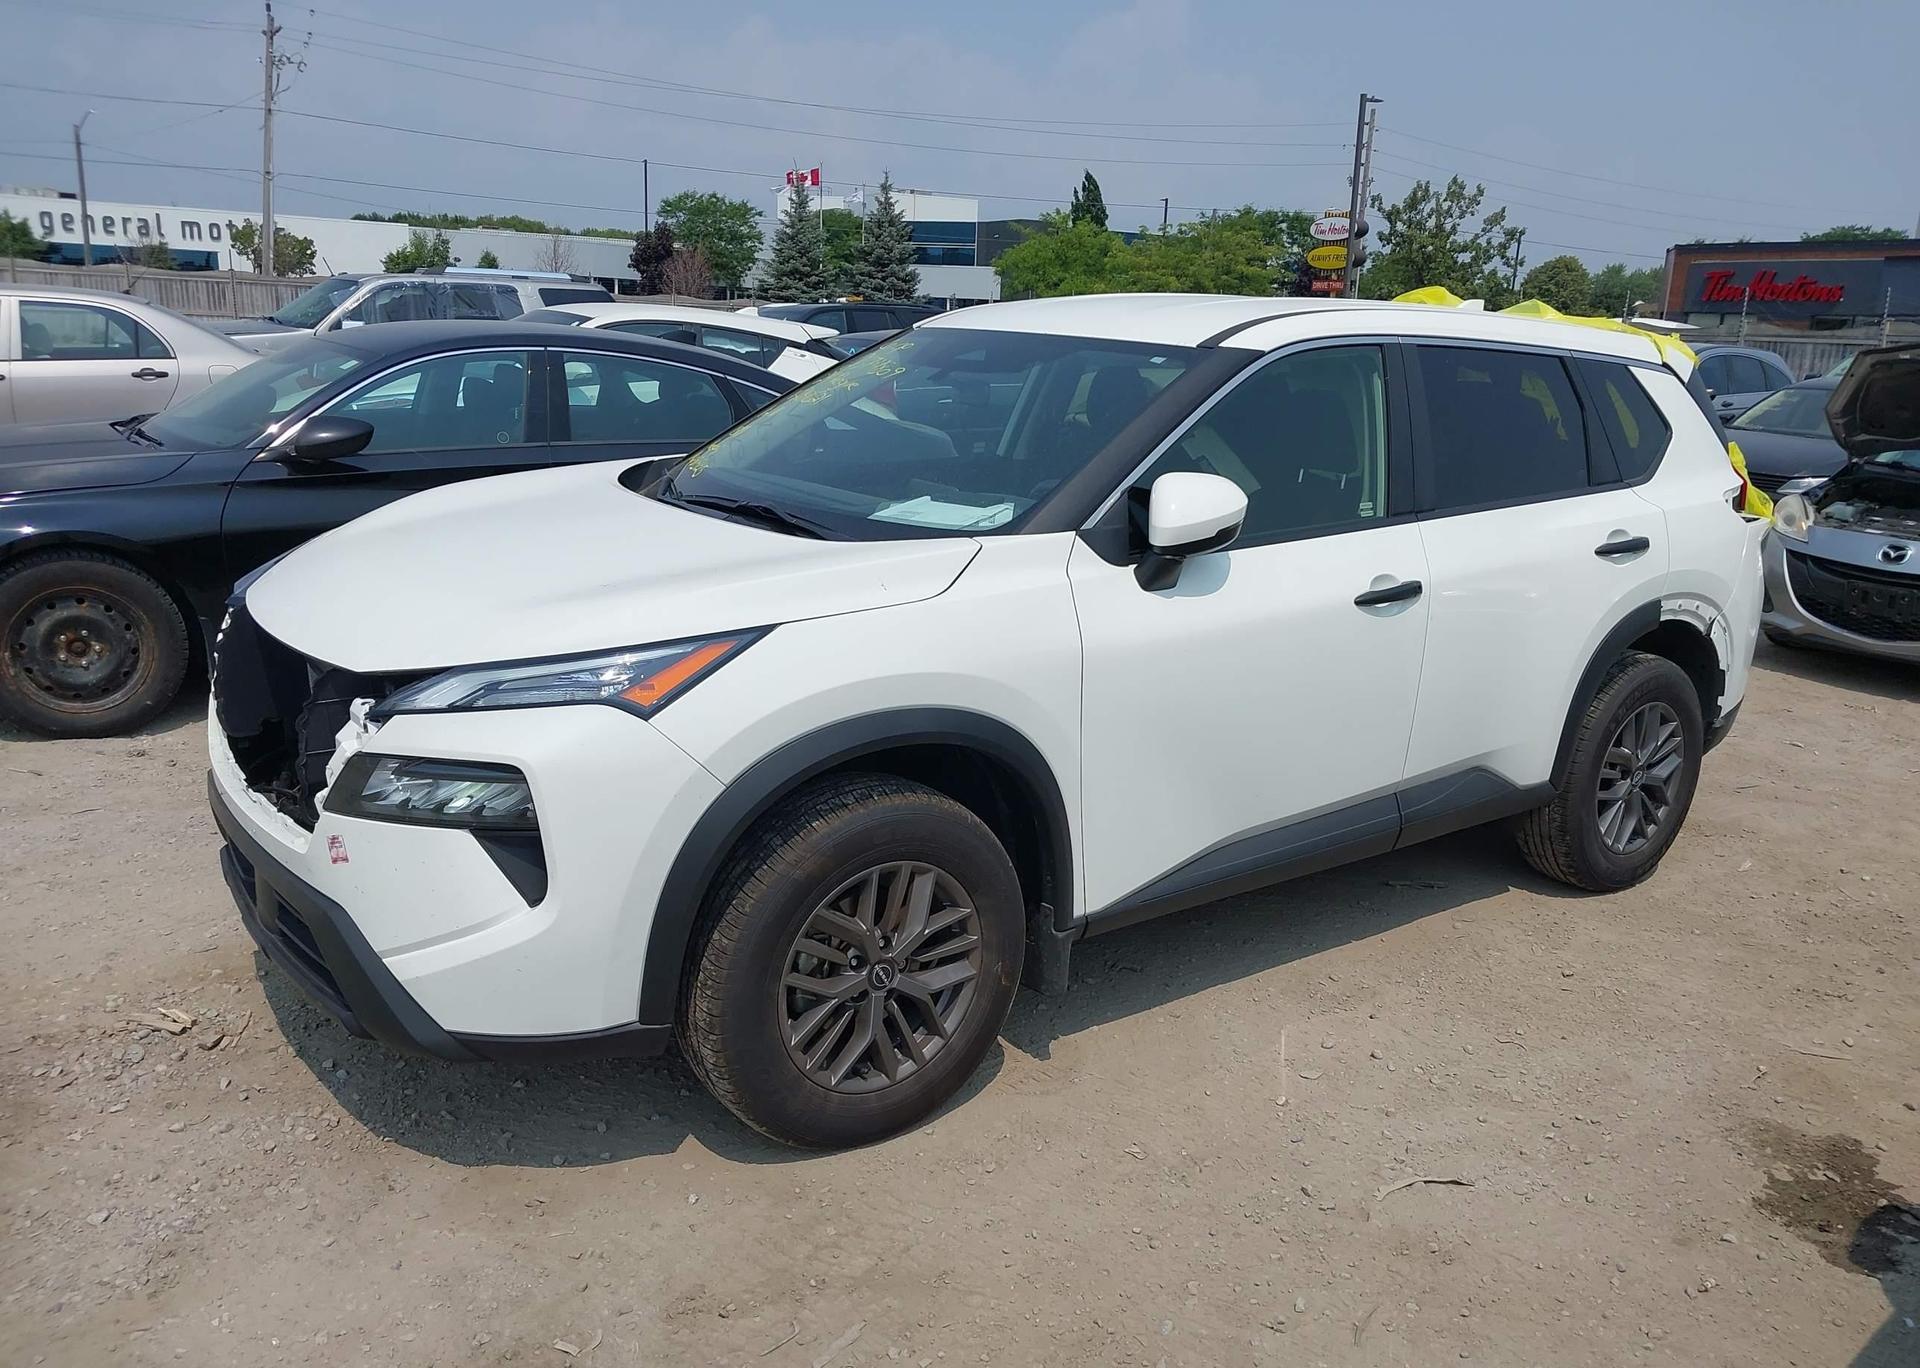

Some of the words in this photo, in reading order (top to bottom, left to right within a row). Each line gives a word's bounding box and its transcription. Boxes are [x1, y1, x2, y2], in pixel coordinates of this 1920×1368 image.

[39, 211, 165, 238] general
[1314, 222, 1326, 236] Tim
[1327, 222, 1349, 236] Horton
[1702, 270, 1746, 302] Tim
[1748, 269, 1844, 302] Hortons
